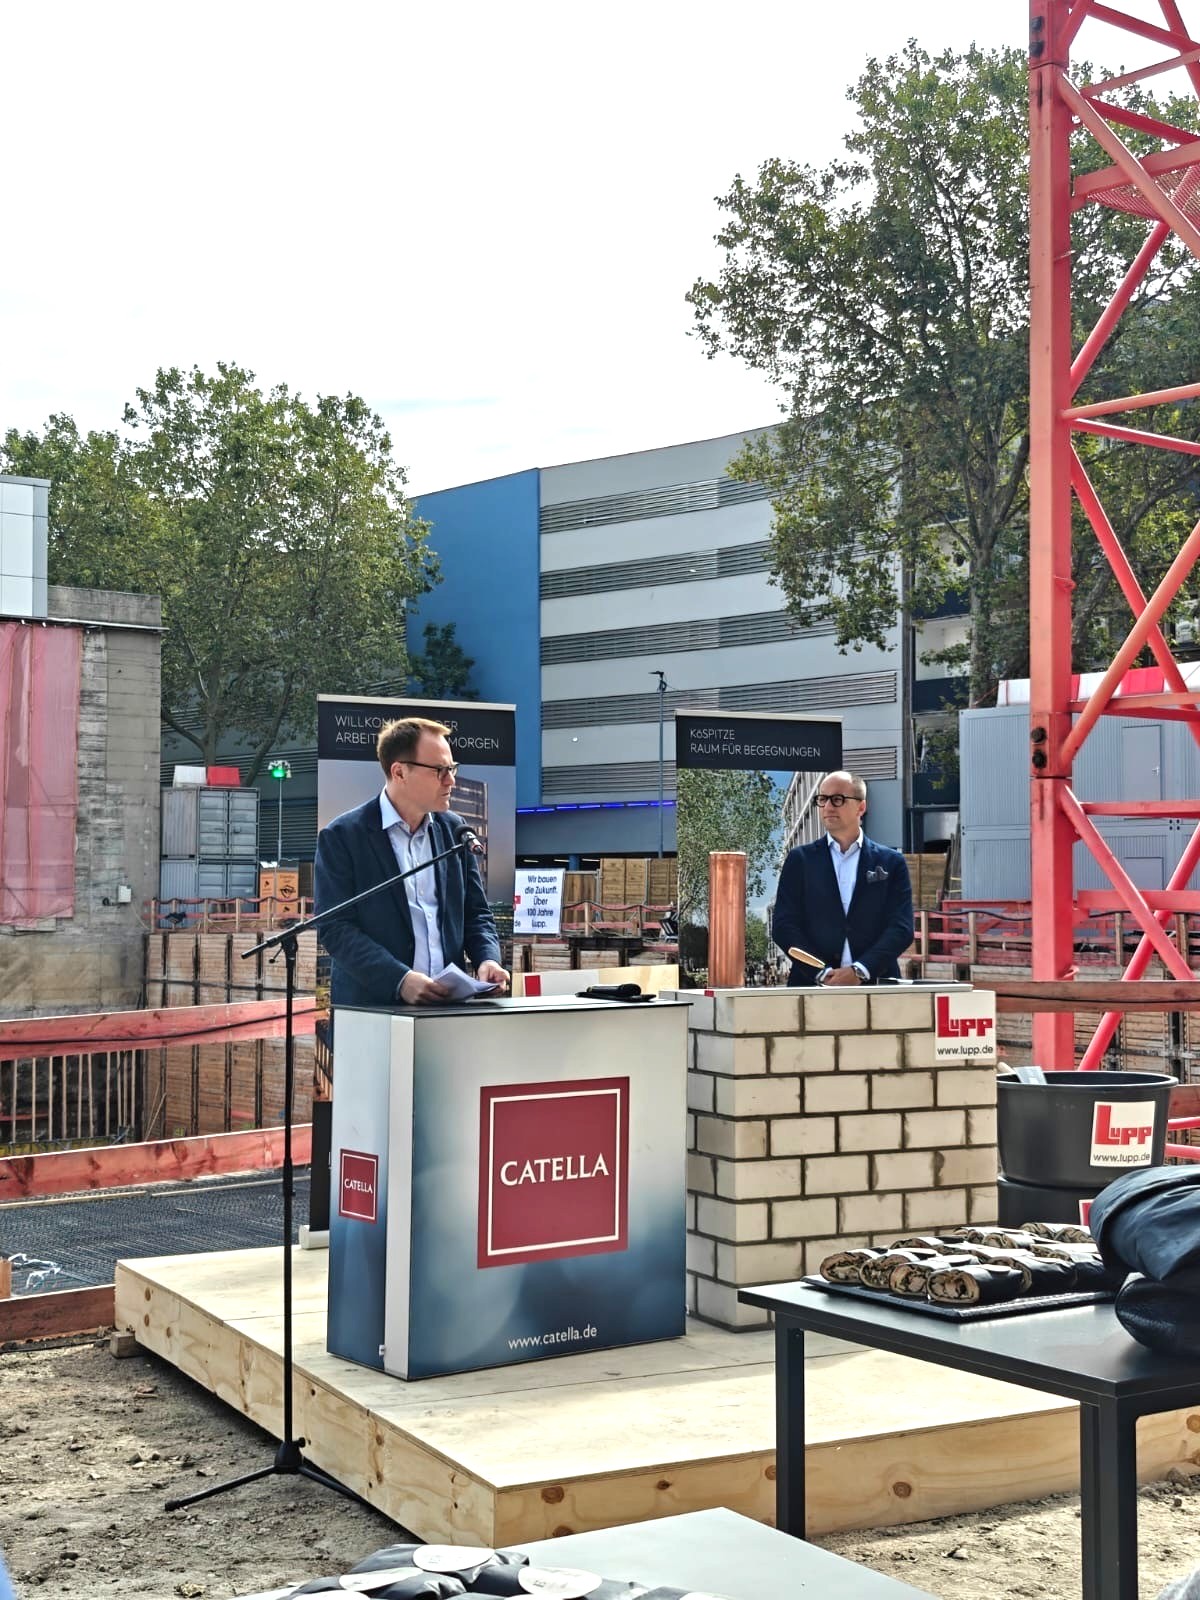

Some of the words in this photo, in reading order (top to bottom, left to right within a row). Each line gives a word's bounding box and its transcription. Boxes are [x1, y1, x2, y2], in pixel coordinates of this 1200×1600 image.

[449, 737, 499, 749] MORGEN
[690, 743, 719, 754] RAUM
[722, 742, 741, 755] FÜR
[744, 745, 821, 757] BEGEGNUNGEN
[528, 875, 537, 883] Wir
[538, 875, 557, 883] bauen
[525, 886, 534, 894] die
[533, 896, 548, 905] Über
[537, 908, 554, 916] Jahre
[937, 1045, 994, 1056] www.lupp.de
[1093, 1152, 1151, 1163] www.lupp.de
[500, 1152, 609, 1186] CATELLA
[344, 1178, 373, 1194] CATELLA
[508, 1323, 598, 1350] www.catella.de
